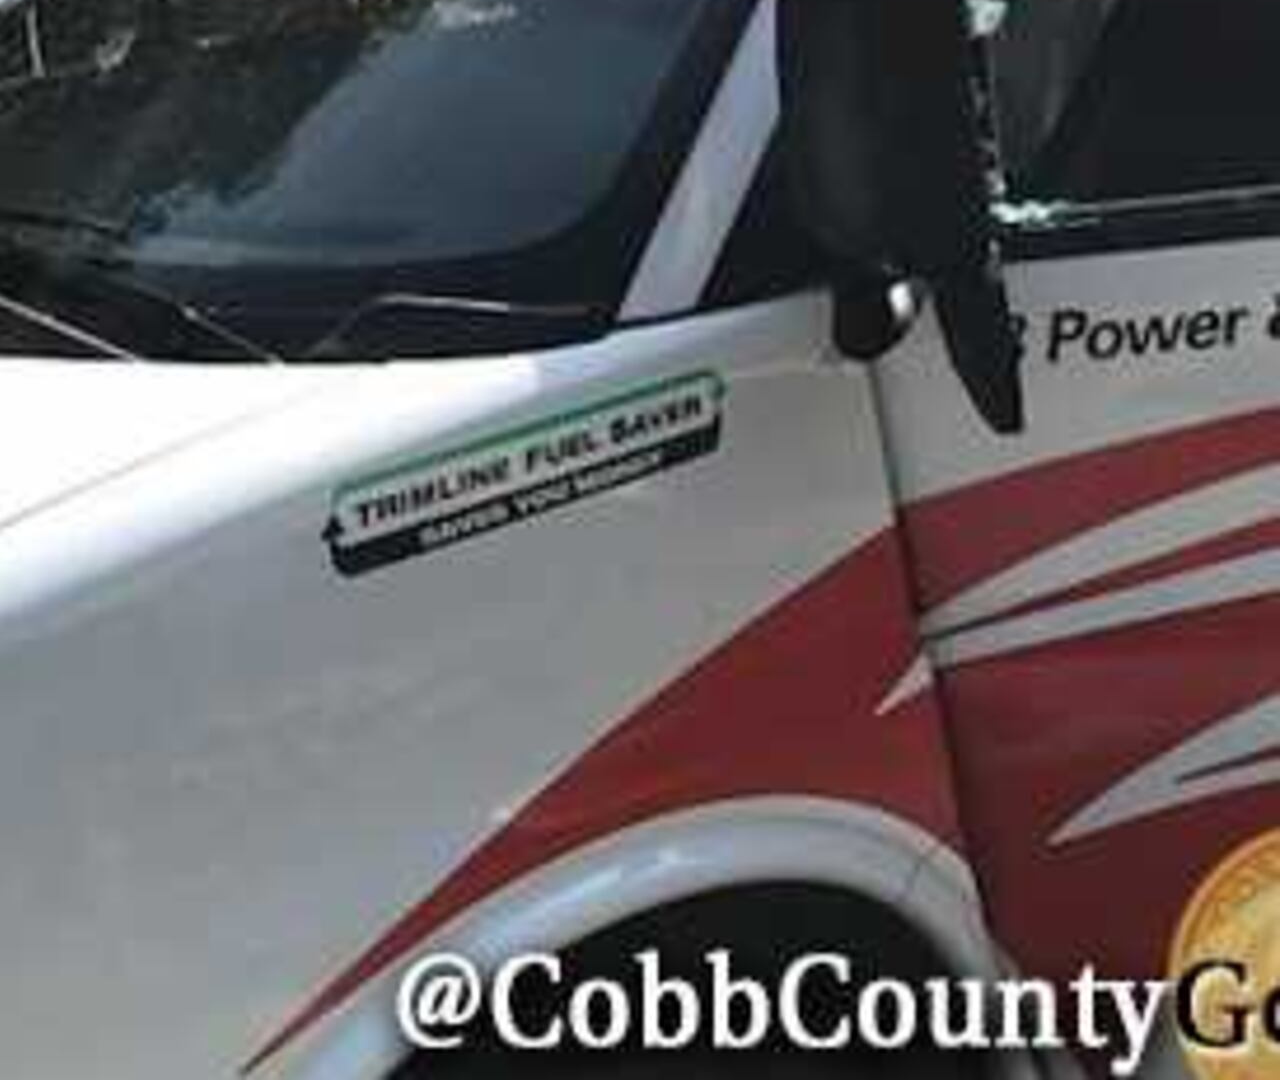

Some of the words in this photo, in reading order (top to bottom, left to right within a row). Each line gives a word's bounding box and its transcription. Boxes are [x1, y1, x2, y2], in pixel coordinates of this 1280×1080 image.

[1045, 307, 1249, 362] Power
[354, 456, 512, 528] TRIMLINE
[524, 428, 601, 472] FUEL
[608, 395, 704, 445] SAVER
